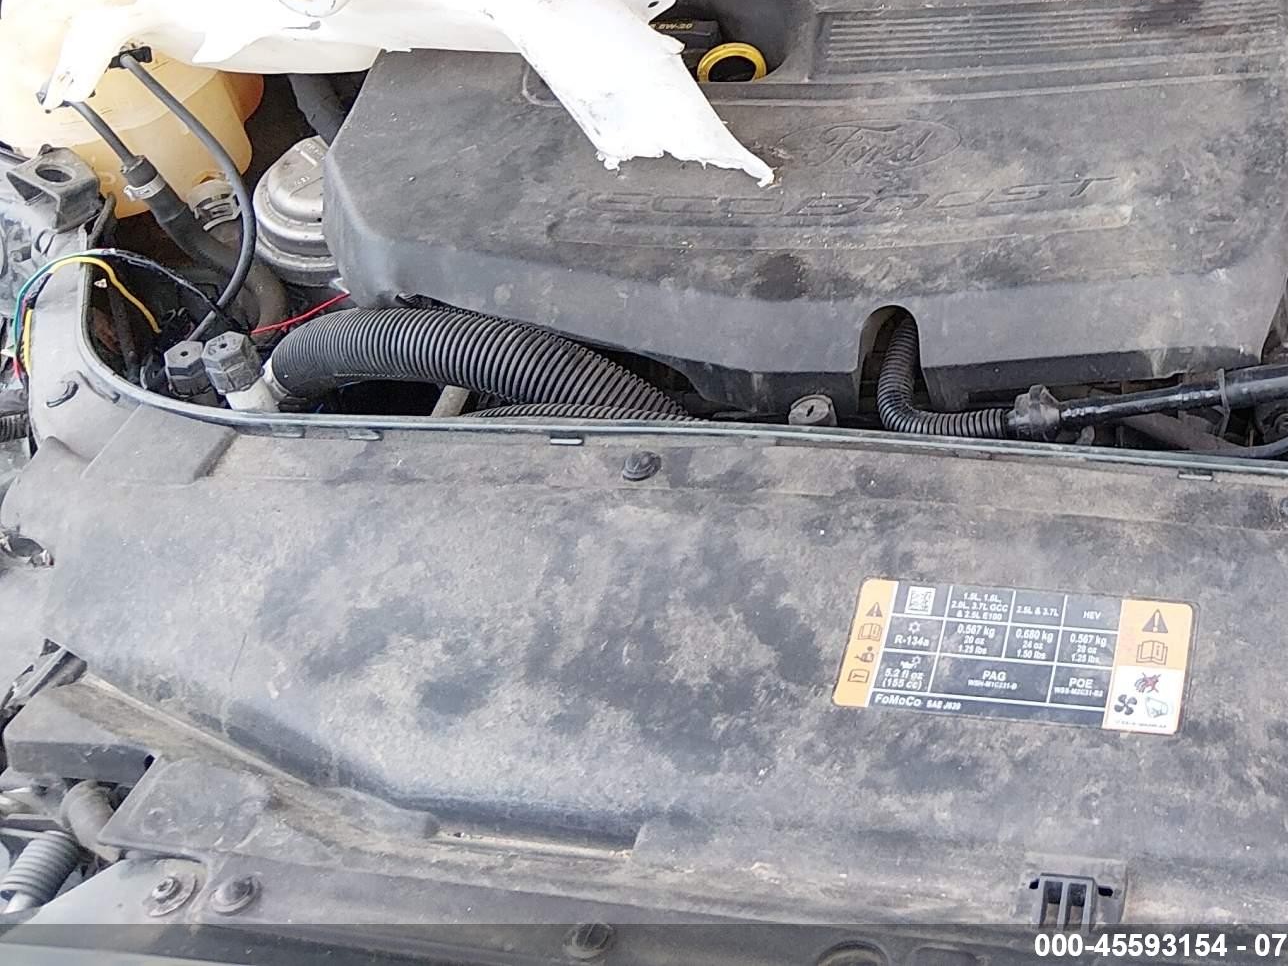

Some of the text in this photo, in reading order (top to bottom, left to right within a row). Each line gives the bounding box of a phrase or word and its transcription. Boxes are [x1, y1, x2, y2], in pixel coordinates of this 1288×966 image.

[819, 123, 933, 165] Ford
[1083, 611, 1102, 620] HEV
[957, 623, 996, 638] 0.567 kg
[1041, 630, 1054, 644] kg
[894, 634, 930, 647] R-134a
[1069, 633, 1108, 649] 0.567 kg
[884, 667, 900, 678] 5.2
[982, 670, 1007, 682] PAG
[882, 677, 923, 691] (155 cc)
[1069, 677, 1095, 689] POE
[874, 693, 922, 707] FoMoCo
